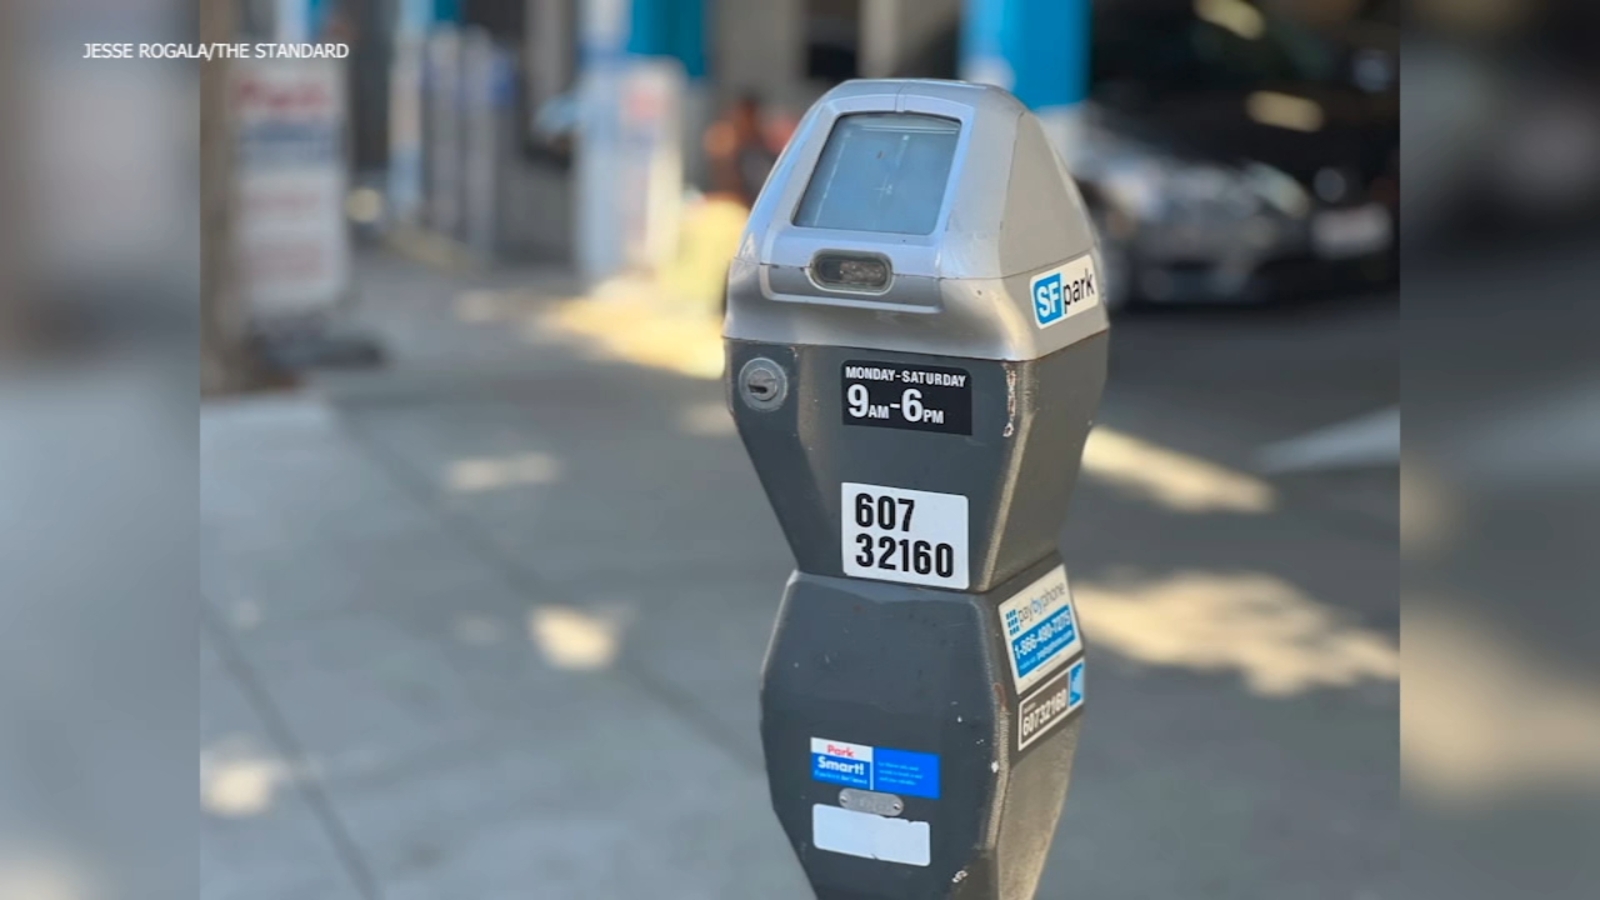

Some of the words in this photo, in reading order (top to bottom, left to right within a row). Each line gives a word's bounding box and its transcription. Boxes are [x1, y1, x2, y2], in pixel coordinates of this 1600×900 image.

[845, 366, 966, 387] MONDAY-SATURDAY
[855, 492, 915, 532] 607
[855, 533, 954, 578] 32160
[827, 744, 854, 758] Park
[817, 755, 865, 776] Smart!
